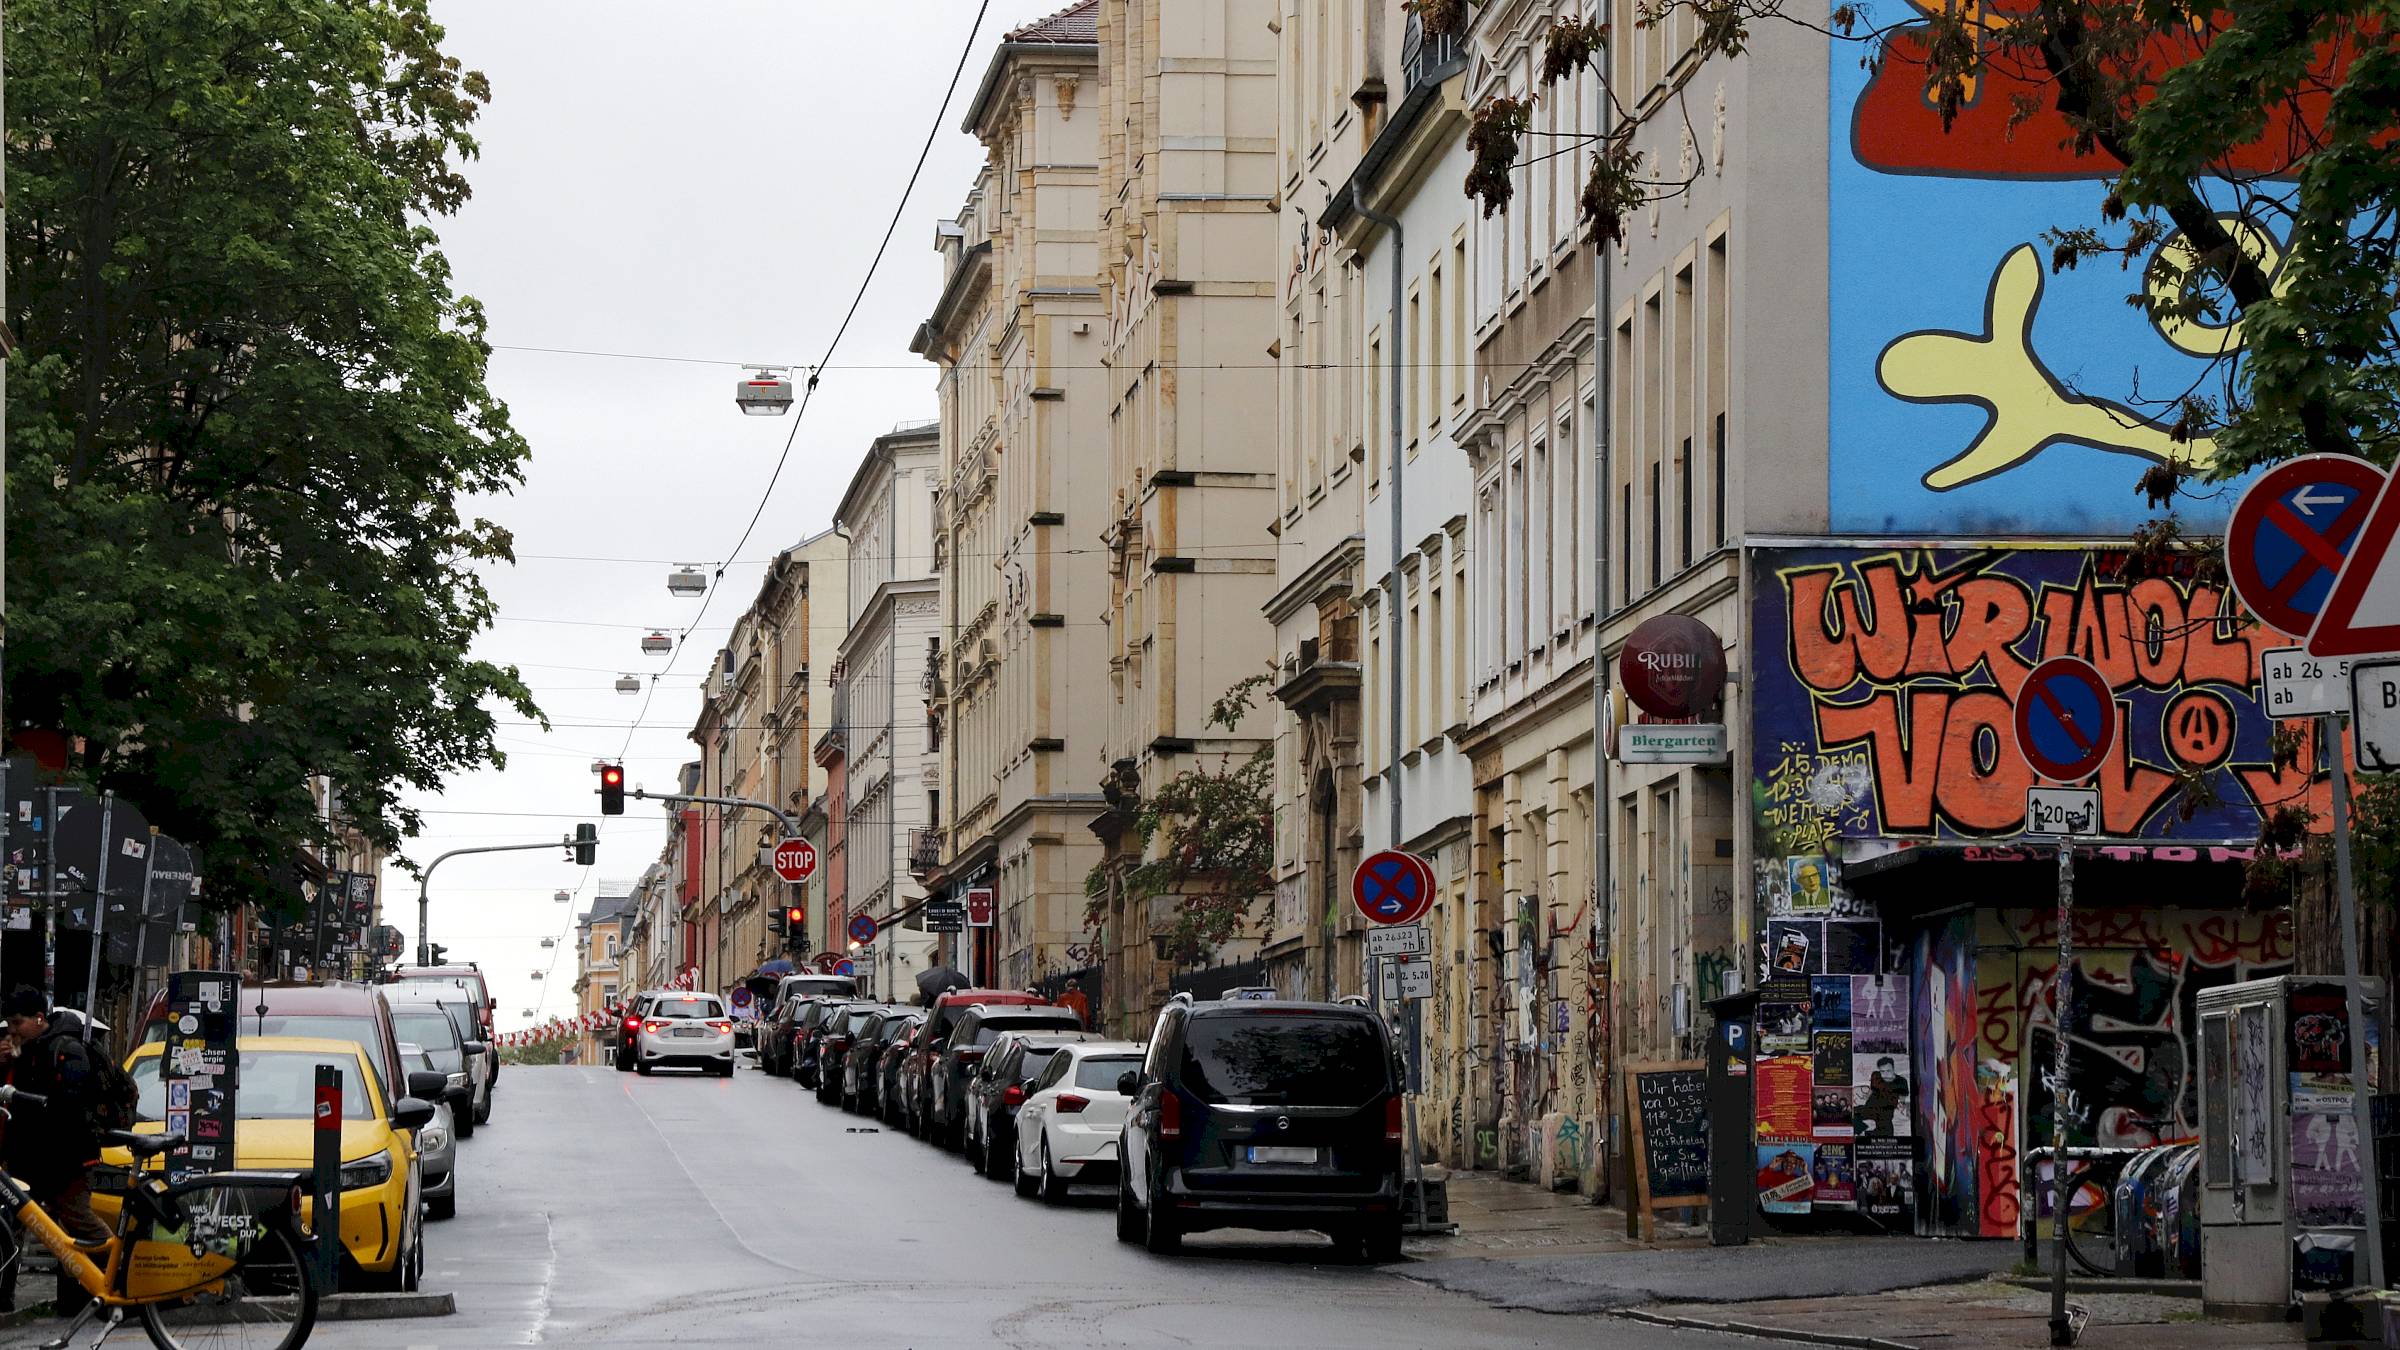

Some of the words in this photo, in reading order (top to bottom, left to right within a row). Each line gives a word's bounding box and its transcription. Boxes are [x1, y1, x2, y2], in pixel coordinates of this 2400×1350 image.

[2273, 662, 2292, 679] ab
[2301, 662, 2323, 679] 26
[2274, 688, 2293, 704] ab
[2382, 681, 2400, 709] B
[1632, 734, 1717, 749] Biergarten
[2044, 806, 2063, 823] 20
[1790, 817, 1843, 848] PLATZ
[777, 851, 812, 870] STOP
[1373, 944, 1382, 952] ab
[1386, 971, 1394, 980] ab
[1729, 1024, 1743, 1047] P
[1641, 1079, 1668, 1095] Wir
[1643, 1099, 1662, 1109] von
[2322, 1096, 2350, 1104] OSTPOL
[1648, 1124, 1674, 1137] und
[1821, 1144, 1846, 1156] SING
[1653, 1150, 1669, 1168] für
[1679, 1148, 1699, 1161] Sie
[189, 1204, 208, 1214] WAS
[240, 1229, 257, 1239] DU?
